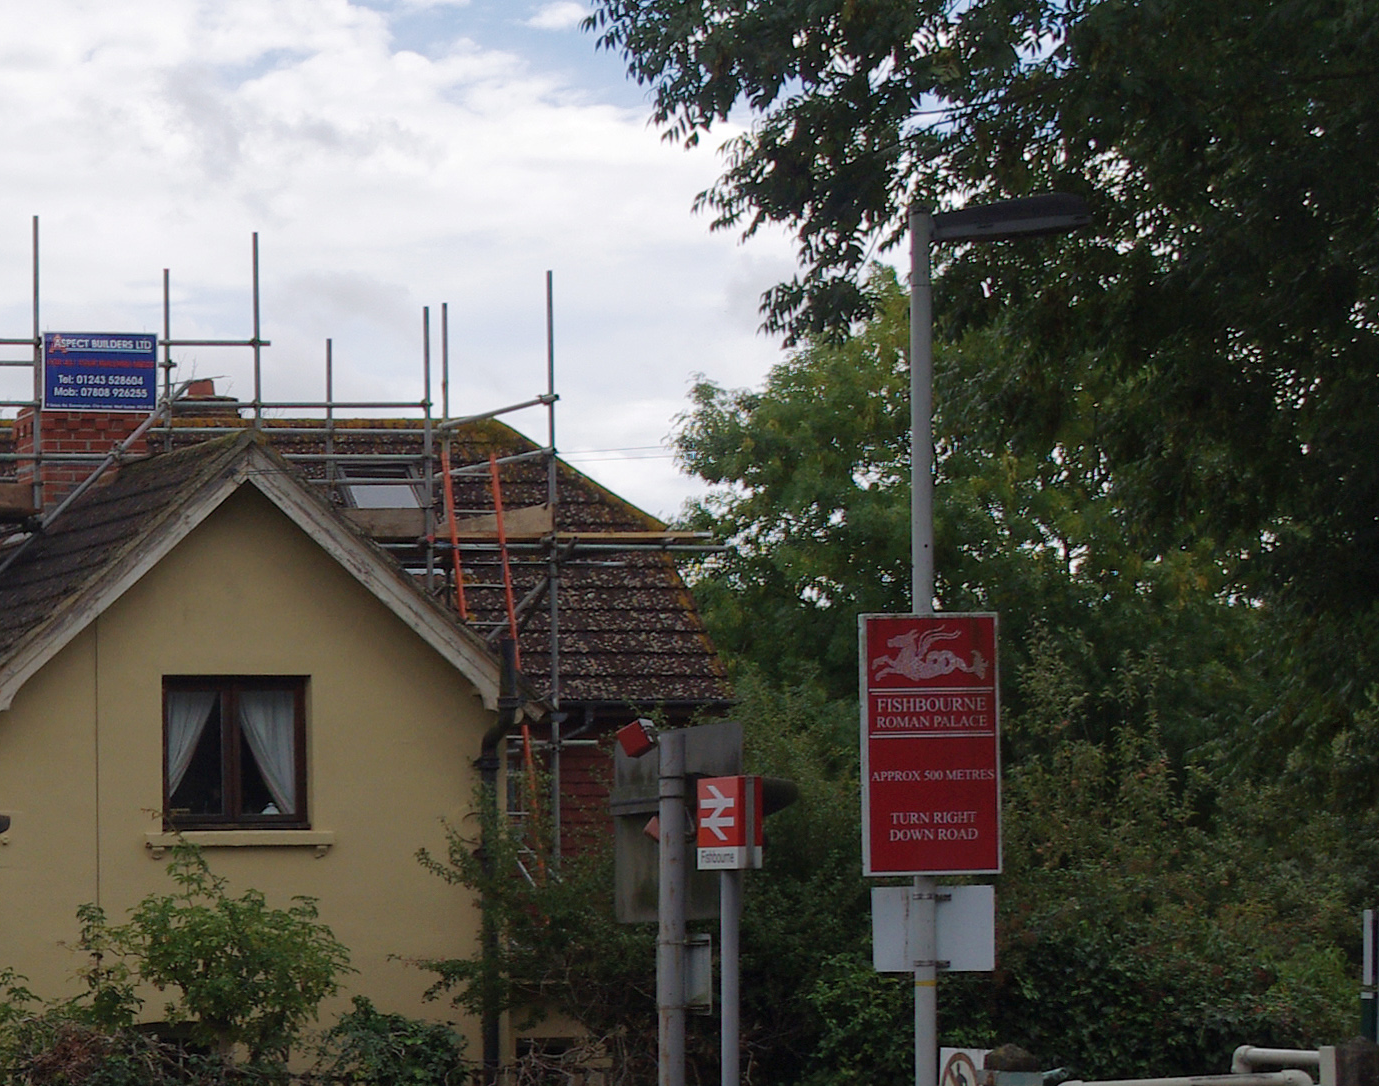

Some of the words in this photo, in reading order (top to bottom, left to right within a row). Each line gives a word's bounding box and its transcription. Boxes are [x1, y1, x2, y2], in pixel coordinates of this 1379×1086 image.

[53, 338, 89, 348] ASPECT
[91, 339, 133, 349] BUILDERS
[135, 340, 152, 350] LTD
[58, 374, 75, 385] Tel:
[76, 374, 106, 385] 01243
[53, 386, 78, 397] Mob:
[80, 387, 110, 397] 07808
[112, 388, 148, 399] 926255
[876, 696, 988, 713] FISHBOURNE
[876, 715, 930, 729] ROMAN
[933, 714, 988, 728] PALACE
[871, 770, 921, 782] APPROX
[924, 769, 943, 781] 500
[946, 768, 995, 781] METRES
[890, 812, 930, 825] TURN
[933, 811, 977, 824] RIGHT
[889, 828, 934, 842] DOWN
[937, 827, 979, 841] ROAD
